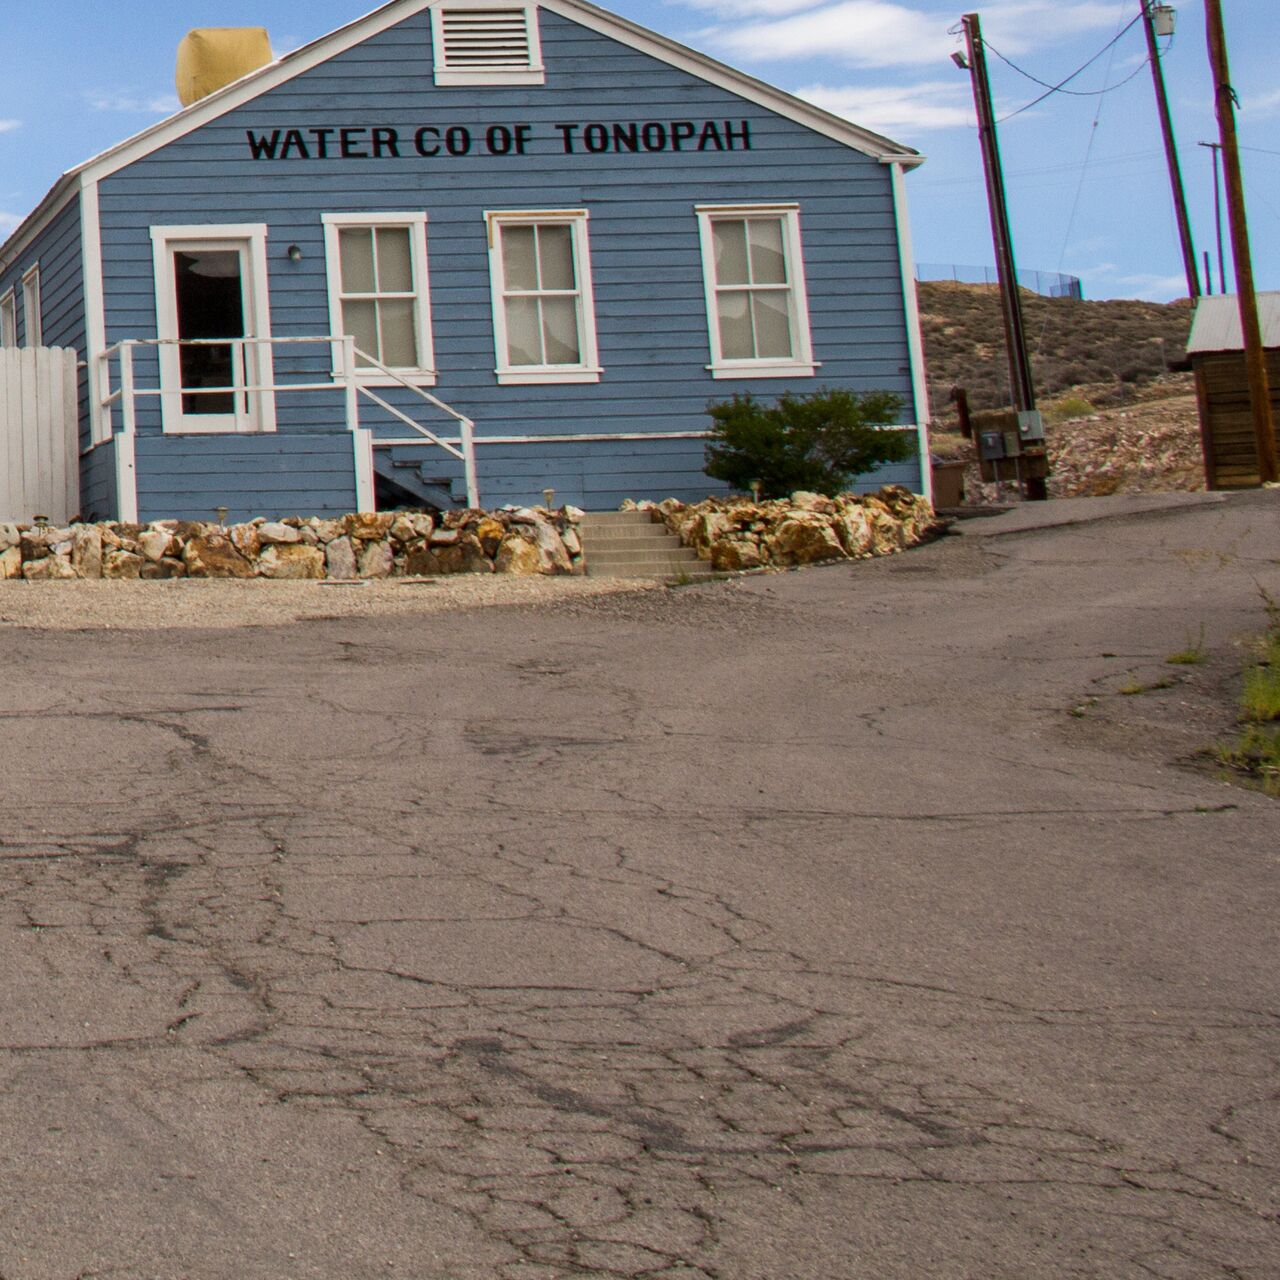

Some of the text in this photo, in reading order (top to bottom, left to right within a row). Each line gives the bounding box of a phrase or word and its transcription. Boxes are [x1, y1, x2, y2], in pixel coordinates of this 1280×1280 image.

[246, 120, 753, 160] WATER CO OF TONOPAH
